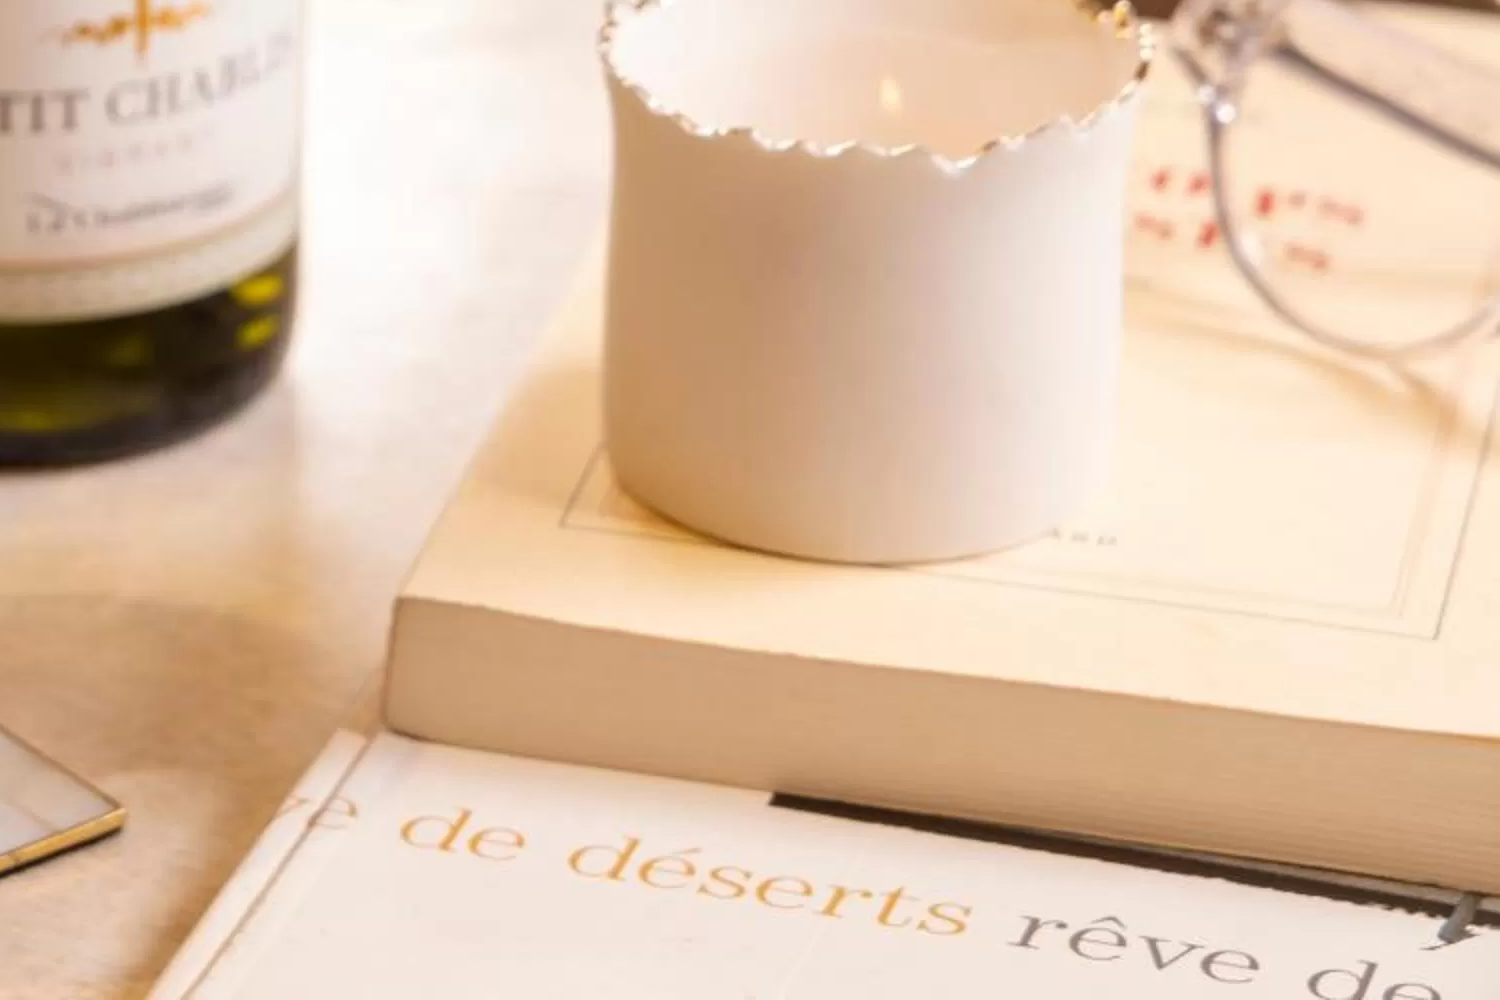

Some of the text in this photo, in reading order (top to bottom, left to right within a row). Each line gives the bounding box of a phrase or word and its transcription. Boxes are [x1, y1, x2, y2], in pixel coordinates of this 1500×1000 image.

[399, 807, 526, 861] de
[566, 835, 973, 937] déserts
[1006, 914, 1261, 985] rêve
